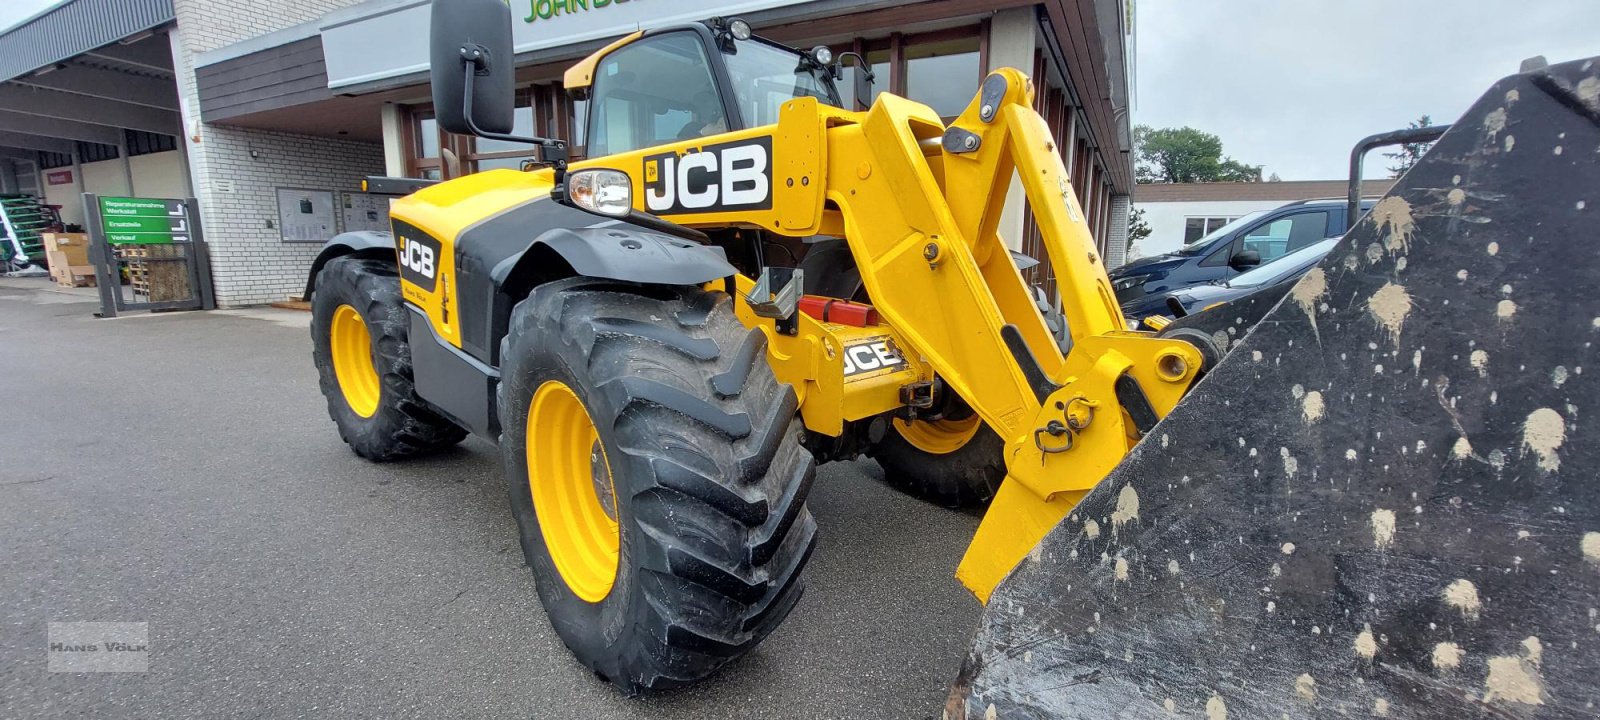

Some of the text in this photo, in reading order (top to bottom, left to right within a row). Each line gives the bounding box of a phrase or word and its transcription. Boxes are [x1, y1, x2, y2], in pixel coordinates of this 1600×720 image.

[524, 0, 588, 23] JOHN
[646, 144, 769, 211] JCB
[401, 238, 434, 279] JCB
